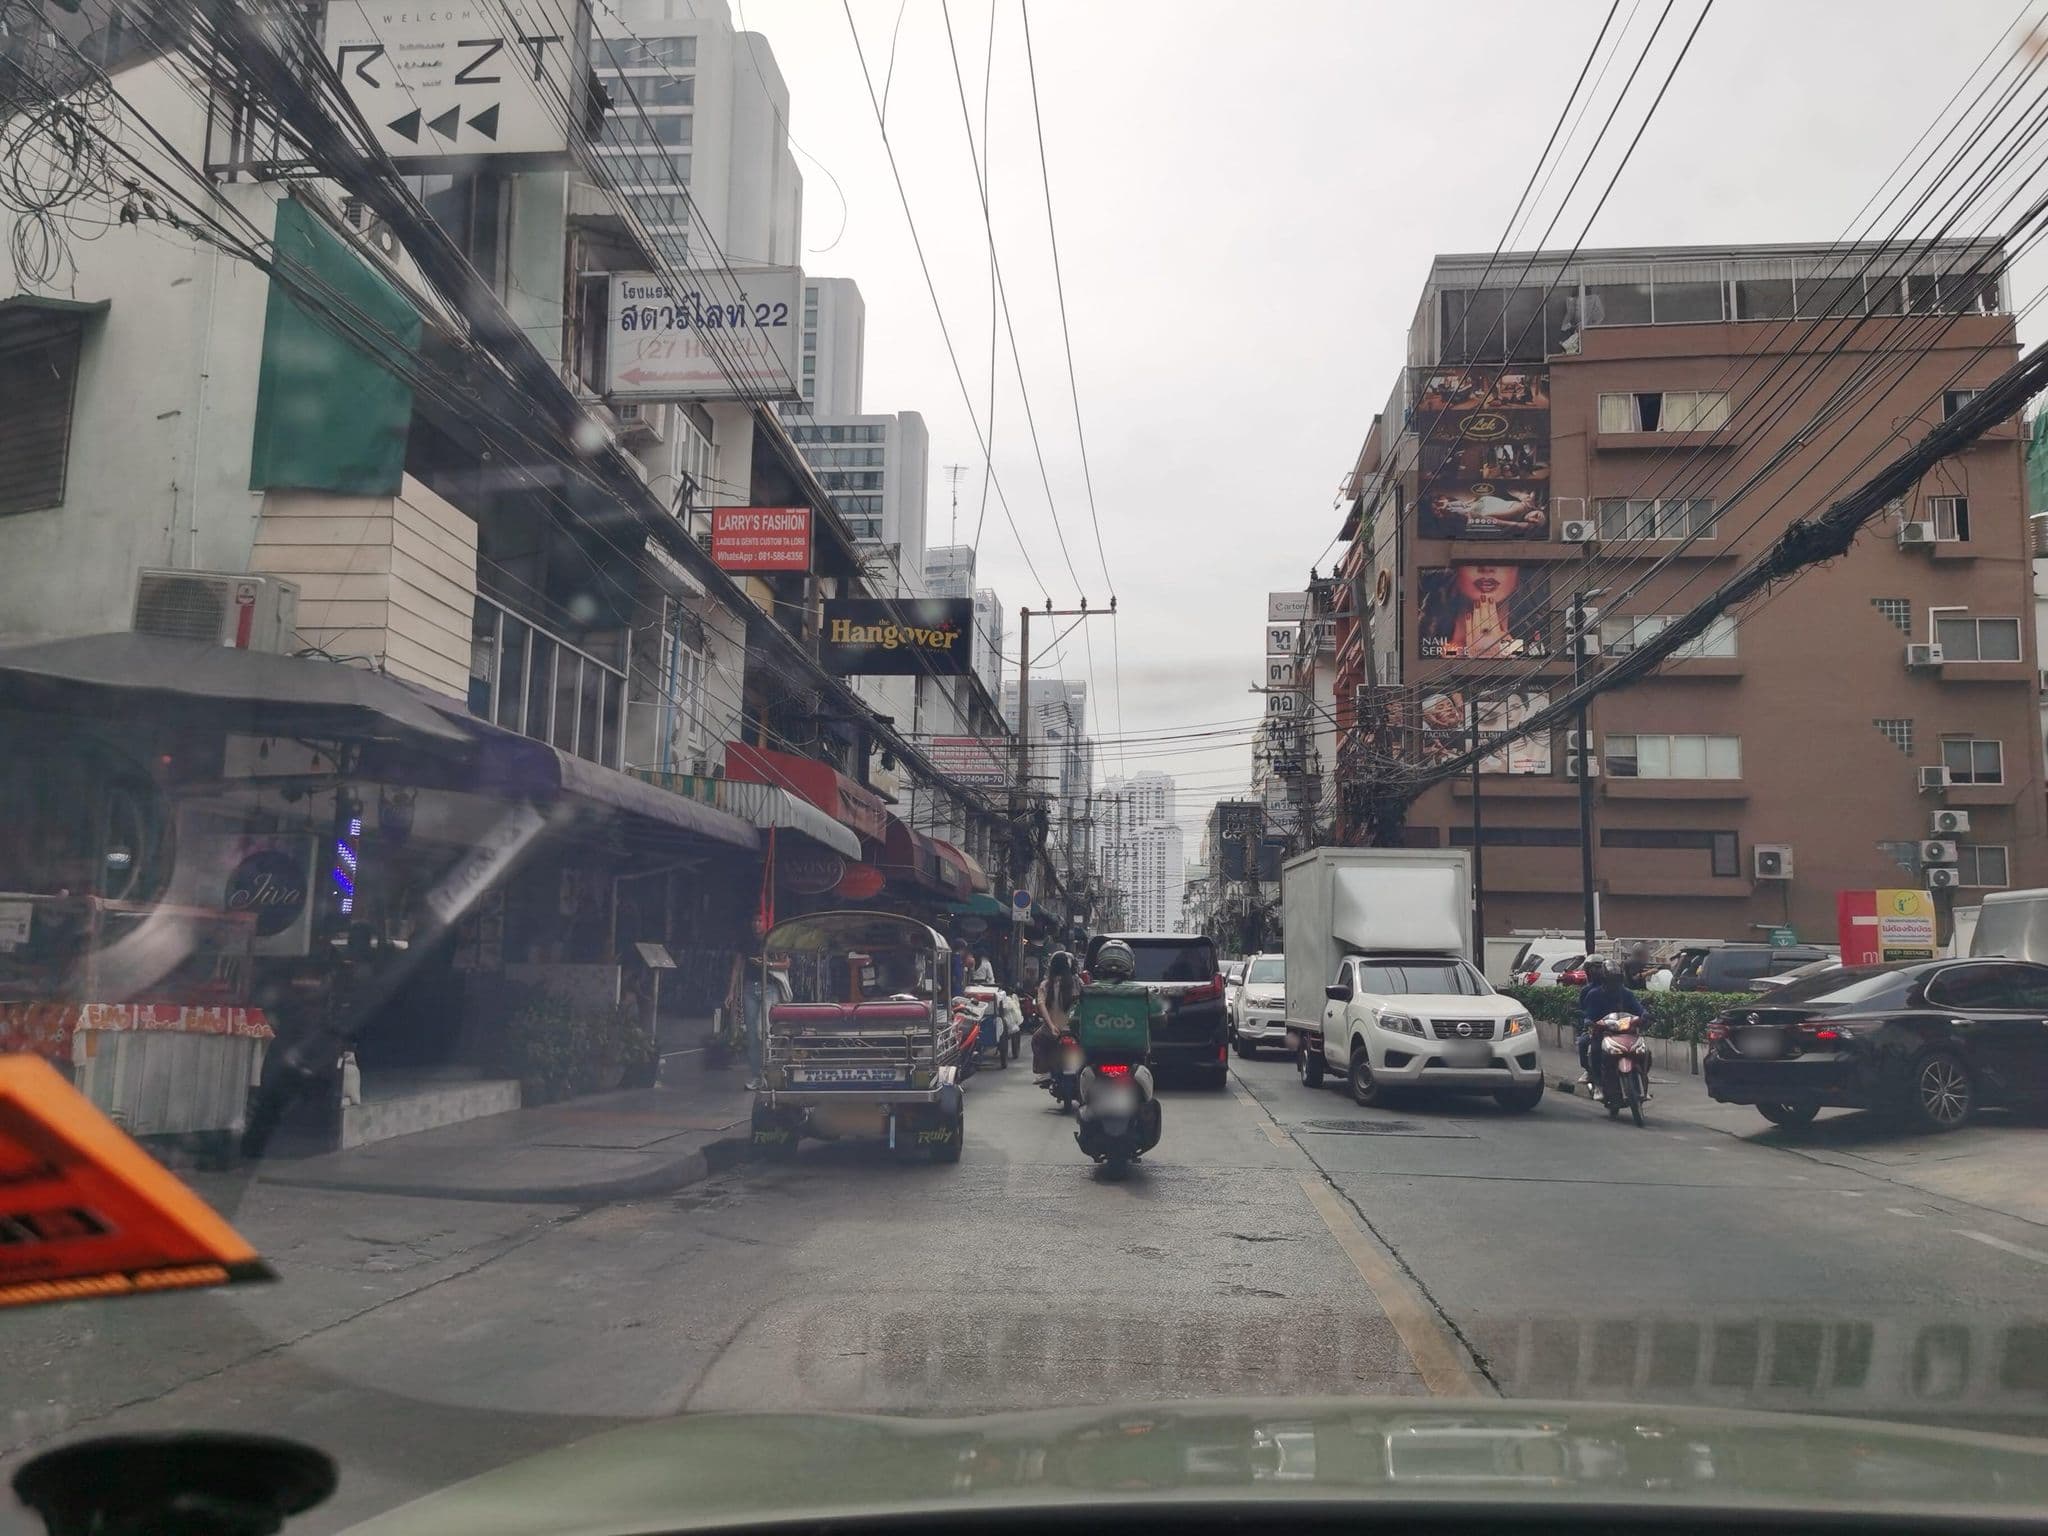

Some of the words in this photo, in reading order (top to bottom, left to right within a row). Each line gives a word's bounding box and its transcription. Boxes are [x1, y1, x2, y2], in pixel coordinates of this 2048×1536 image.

[383, 9, 487, 24] WELCOME
[755, 303, 788, 327] 22
[718, 514, 760, 531] LARRY'S
[762, 514, 805, 530] FASHION
[717, 551, 753, 562] WhatsApp
[831, 618, 959, 650] Hangover
[1422, 636, 1449, 645] NAIL
[1094, 1012, 1136, 1030] Grab
[803, 1068, 897, 1081] THAILAND
